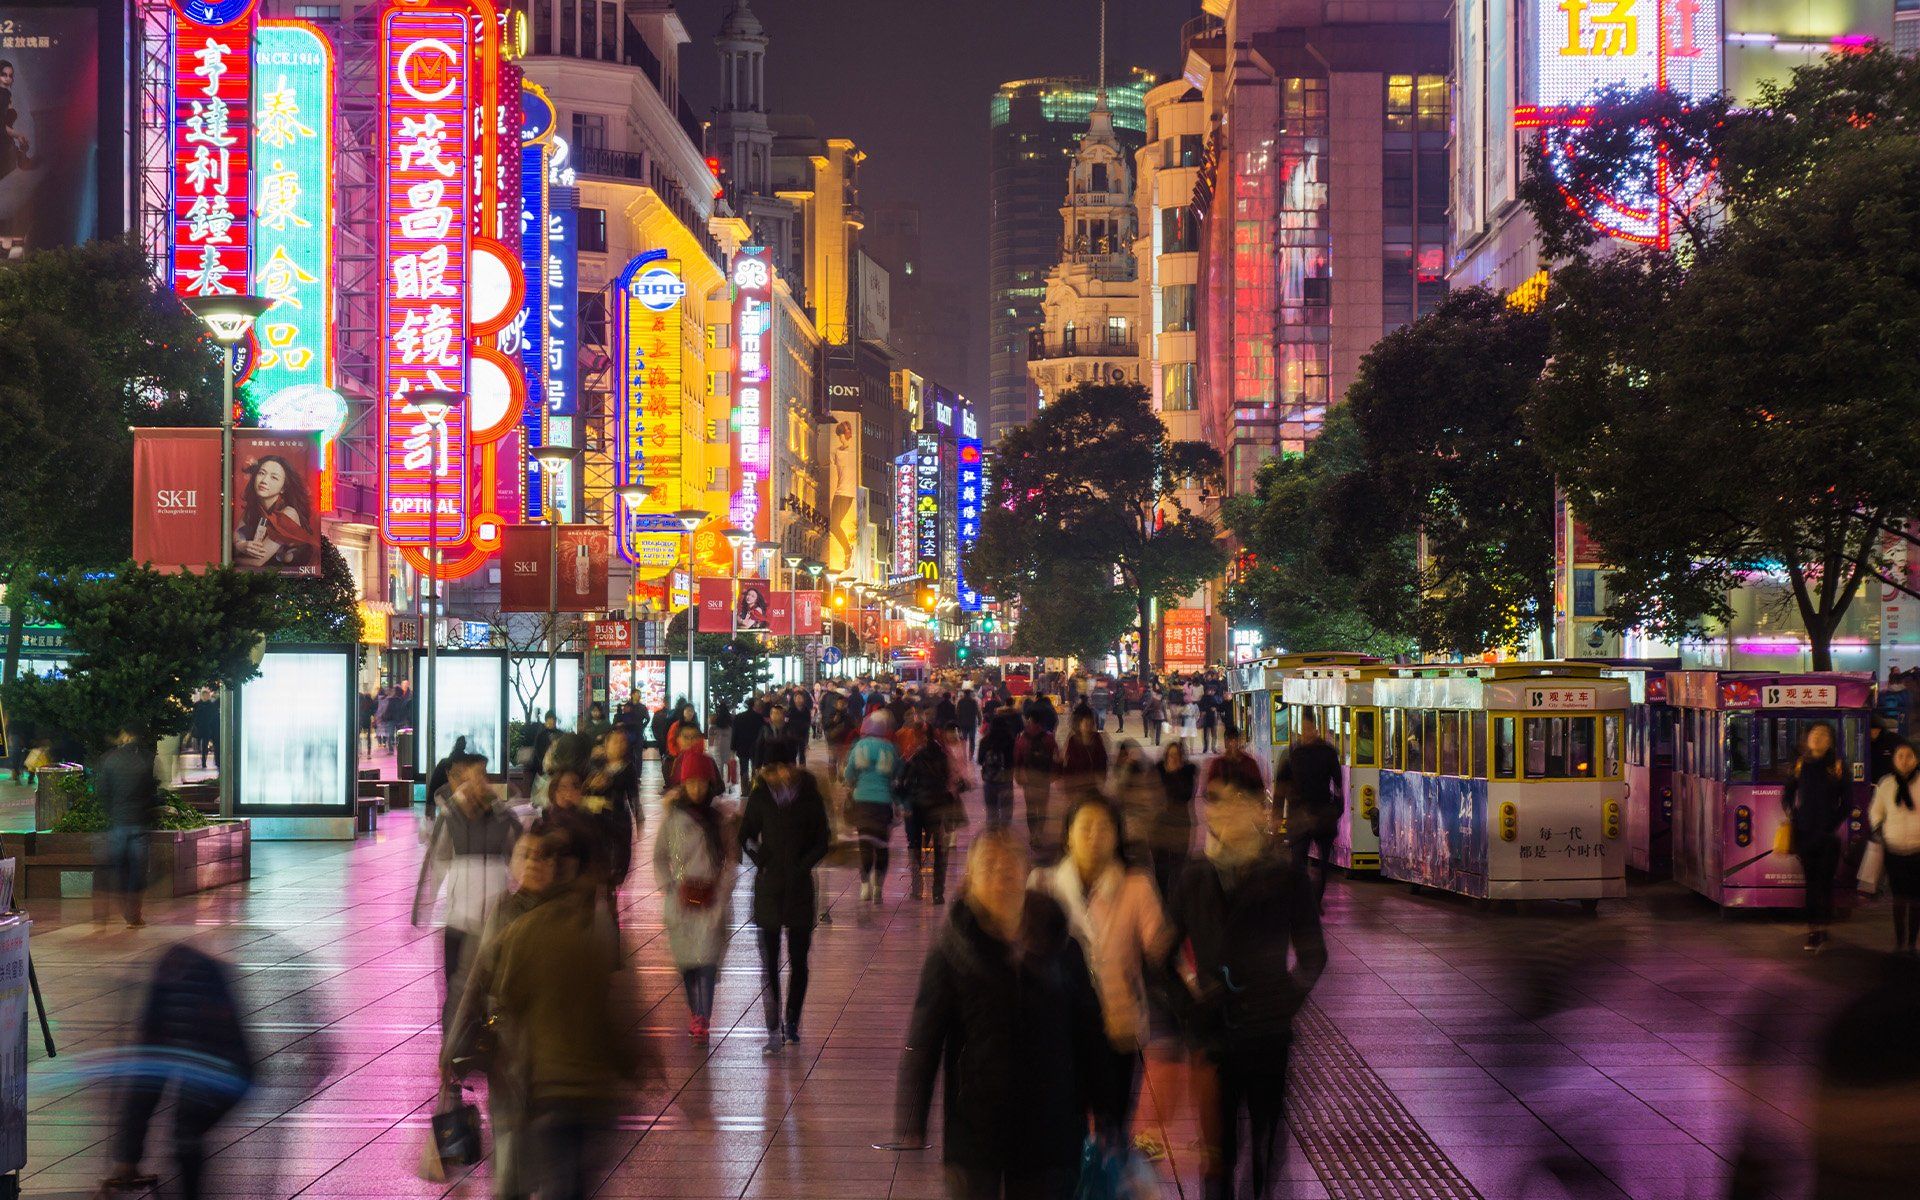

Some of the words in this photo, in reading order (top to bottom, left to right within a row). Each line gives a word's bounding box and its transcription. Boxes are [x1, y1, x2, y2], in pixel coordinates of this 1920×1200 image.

[256, 74, 319, 371] 泰康食品
[393, 113, 458, 477] 茂昌眼镜公司
[634, 284, 685, 295] BAC
[231, 347, 247, 375] CHES
[157, 490, 197, 507] SK-II
[391, 498, 458, 514] OPTIAL
[923, 519, 936, 557] 真丝大王
[595, 625, 614, 633] BUS
[1165, 628, 1183, 641] 年终
[1549, 692, 1589, 702] 观光车
[1786, 688, 1828, 699] 观光车
[1612, 762, 1618, 776] 2
[1854, 764, 1863, 779] 10
[1540, 827, 1582, 841] 每一代
[1520, 844, 1606, 859] 都是一个时代
